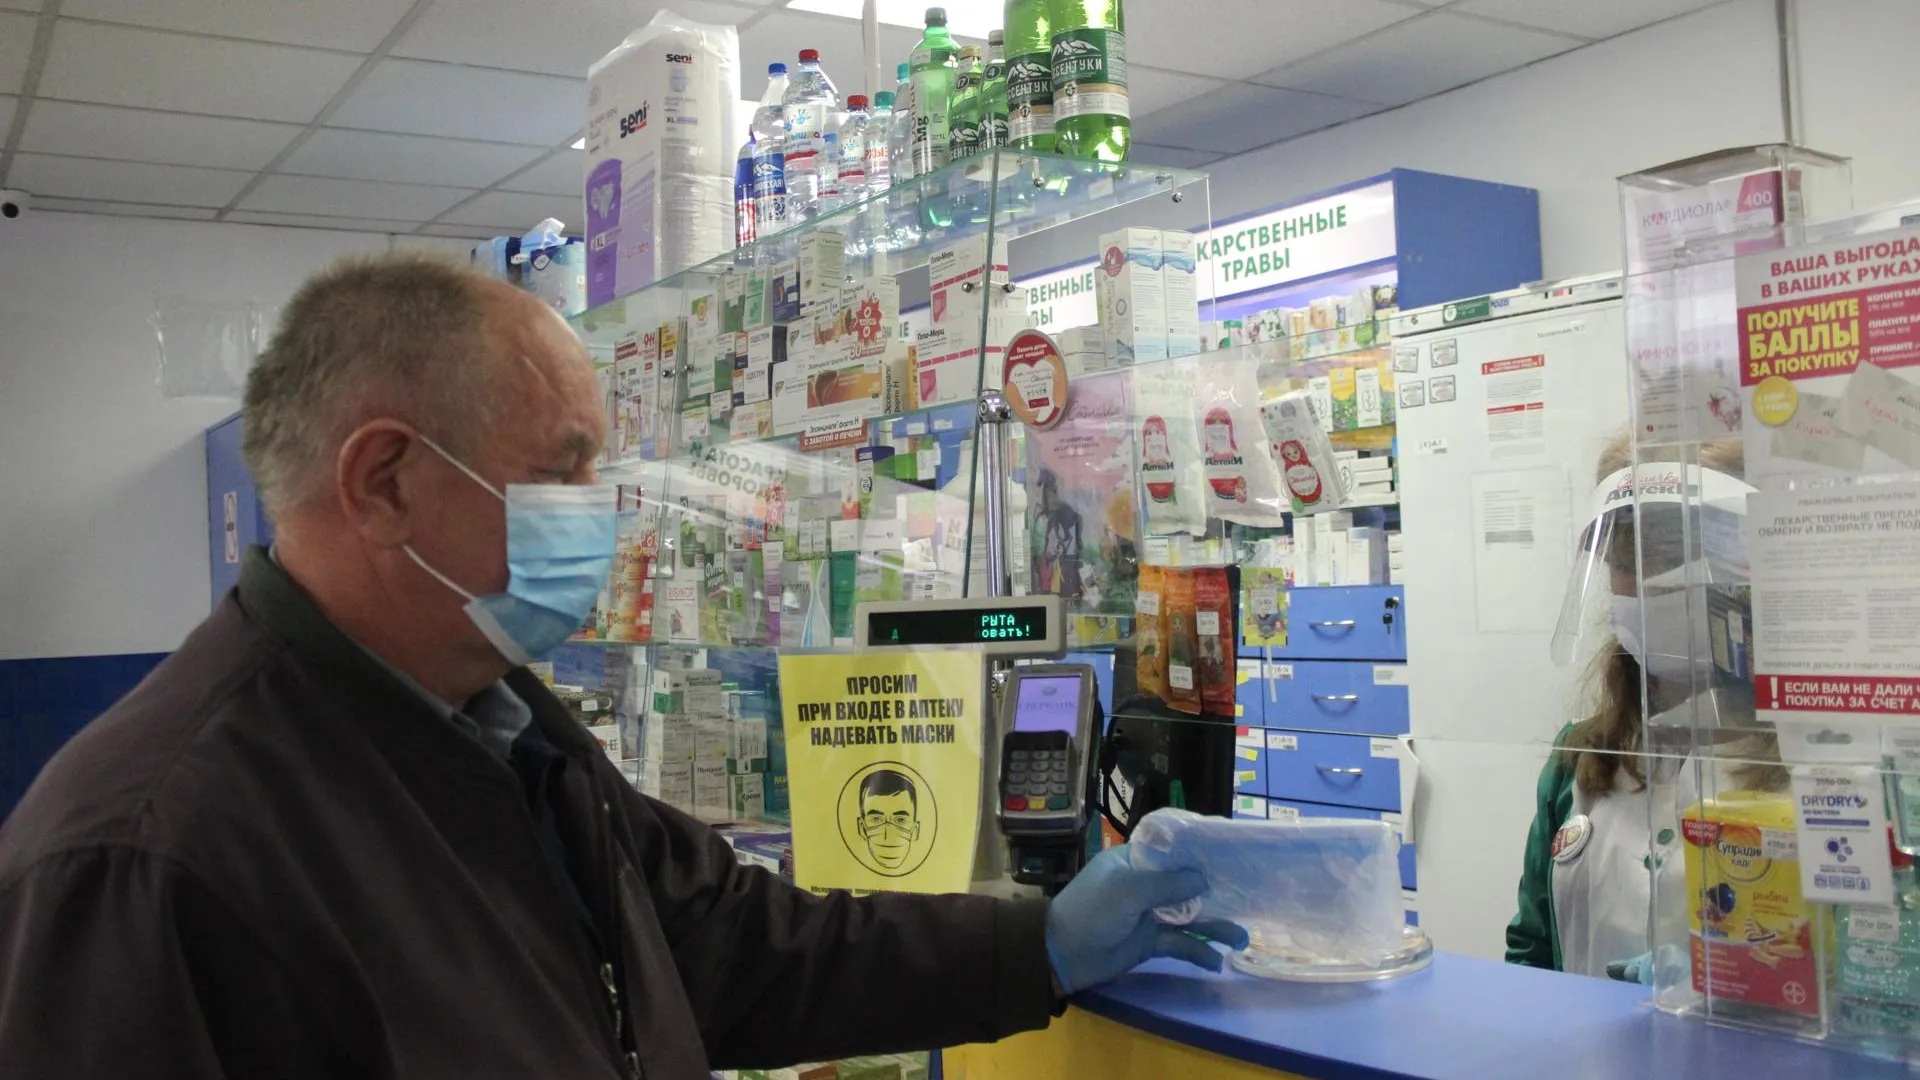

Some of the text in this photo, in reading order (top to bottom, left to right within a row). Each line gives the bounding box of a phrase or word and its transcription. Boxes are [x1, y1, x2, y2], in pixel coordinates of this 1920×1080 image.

[666, 53, 693, 63] seni
[620, 100, 648, 139] seni
[917, 115, 929, 142] Mg
[1743, 191, 1772, 207] 400
[1222, 248, 1290, 282] ТРАВЫ
[1770, 236, 1920, 277] ВАША ВЫГОДА
[1761, 284, 1773, 298] В
[1778, 273, 1851, 297] ВАШИХ
[1748, 298, 1860, 333] ПОЛУЧИТЕ
[1750, 321, 1859, 360] БАЛЛЫ
[1751, 350, 1860, 378] ЗА ПОКУПКУ
[809, 433, 834, 445] ЗАБОТОЙ
[1758, 524, 1802, 538] ОБМЕНУ
[1805, 525, 1813, 534] И
[1816, 522, 1874, 534] ВОЗВРАТУ
[1877, 521, 1892, 531] НЕ
[1774, 511, 1870, 527] ЛЕКАРСТВЕННЫЕ
[981, 615, 1015, 627] РЫТА
[981, 625, 1031, 638] овать!
[846, 674, 918, 696] ПРОСИМ
[1785, 682, 1818, 693] ЕСЛИ
[1822, 682, 1850, 694] ВАМ
[1853, 683, 1872, 695] НЕ
[1874, 684, 1913, 699] ДАЛИ
[798, 698, 964, 723] ПРИ ВХОДЕ В АПТЕКУ
[1785, 695, 1845, 707] ПОКУПКА
[1849, 697, 1867, 708] ЗА
[1871, 698, 1907, 709] СЧЕТ
[811, 724, 956, 748] НАДЕВАТЬ МАСКИ
[1801, 795, 1854, 808] DRYDRY
